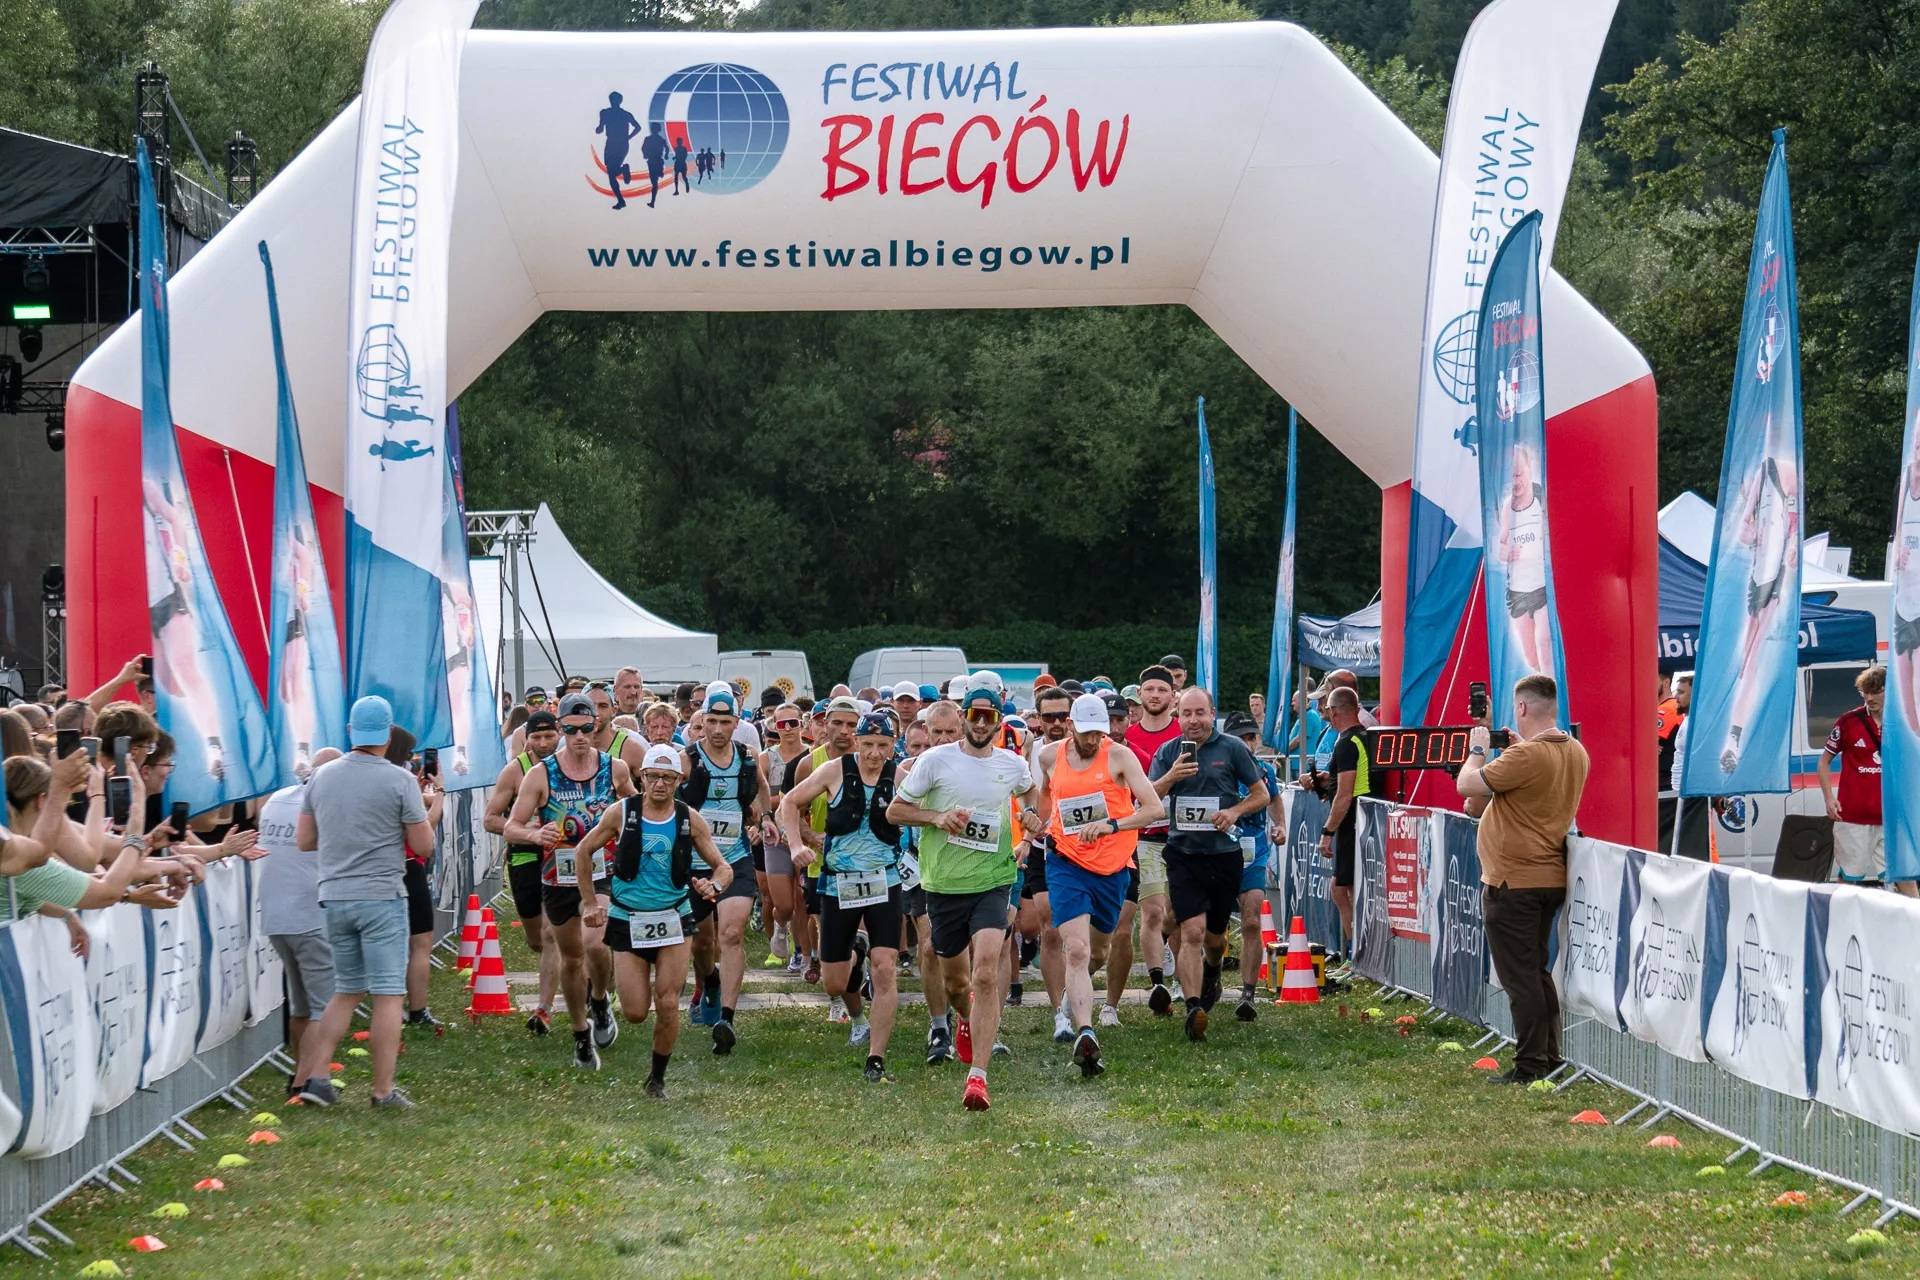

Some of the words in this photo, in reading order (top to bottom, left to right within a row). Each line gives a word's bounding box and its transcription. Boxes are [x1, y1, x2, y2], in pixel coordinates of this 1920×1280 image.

[822, 60, 1027, 105] FESTIWAL
[820, 95, 1130, 209] BIEGÓW
[1465, 107, 1509, 288] FESTIWAL
[370, 114, 406, 301] FESTIWAL
[587, 236, 1131, 272] www.festiwalbiegow.pl
[1072, 806, 1093, 822] 97
[1185, 807, 1206, 821] 57
[713, 820, 729, 835] 17
[965, 821, 990, 840] 63
[855, 882, 871, 897] 11
[645, 922, 667, 938] 28
